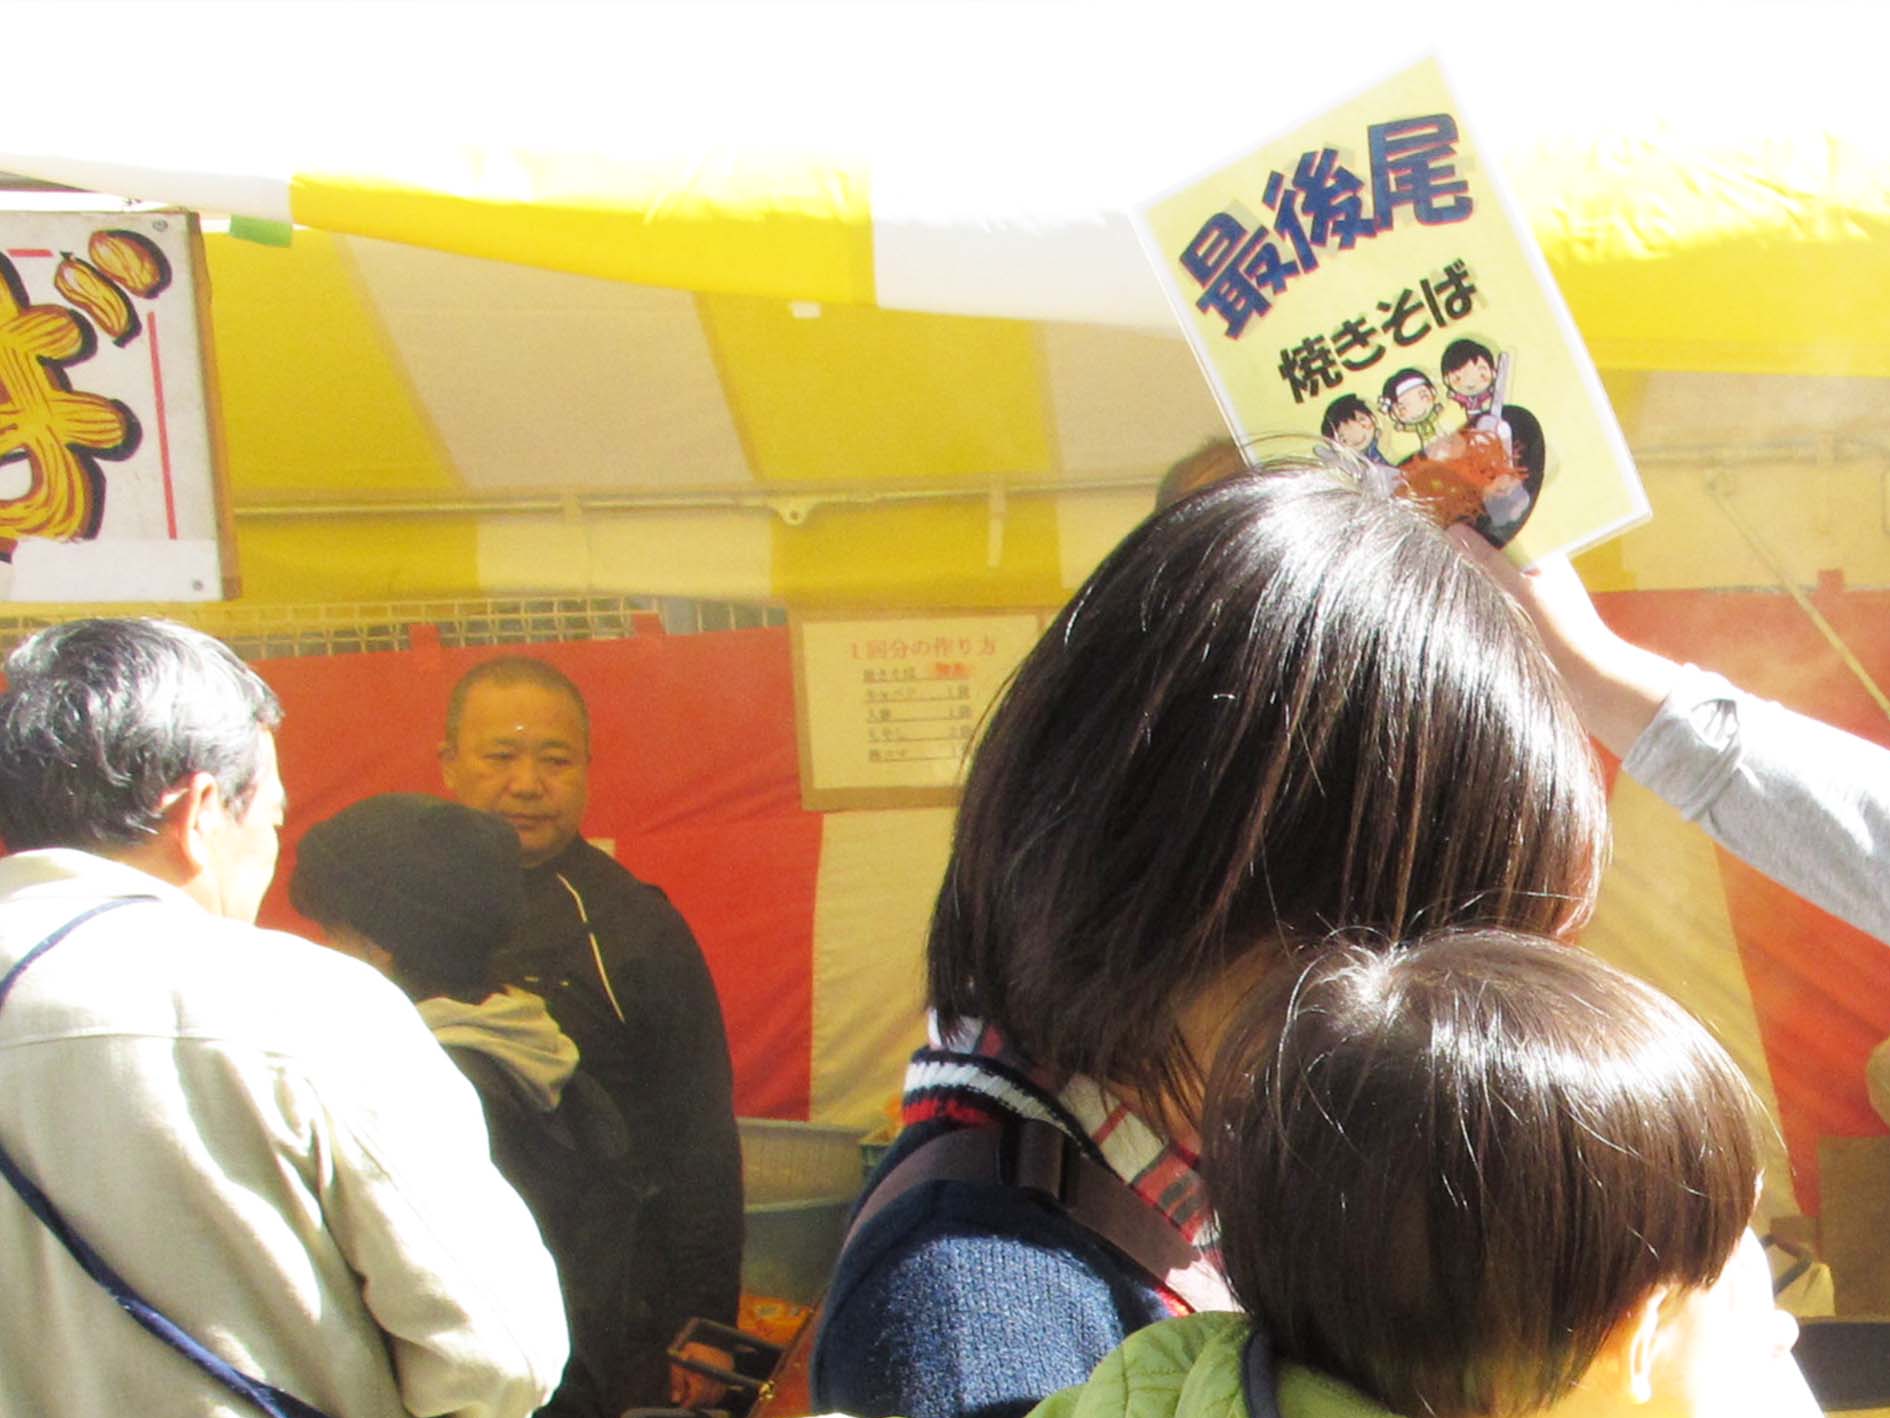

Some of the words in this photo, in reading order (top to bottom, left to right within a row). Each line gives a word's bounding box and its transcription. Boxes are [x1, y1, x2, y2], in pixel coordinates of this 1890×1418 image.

[1178, 112, 1475, 341] 最後尾
[1276, 257, 1479, 405] 焼きそば
